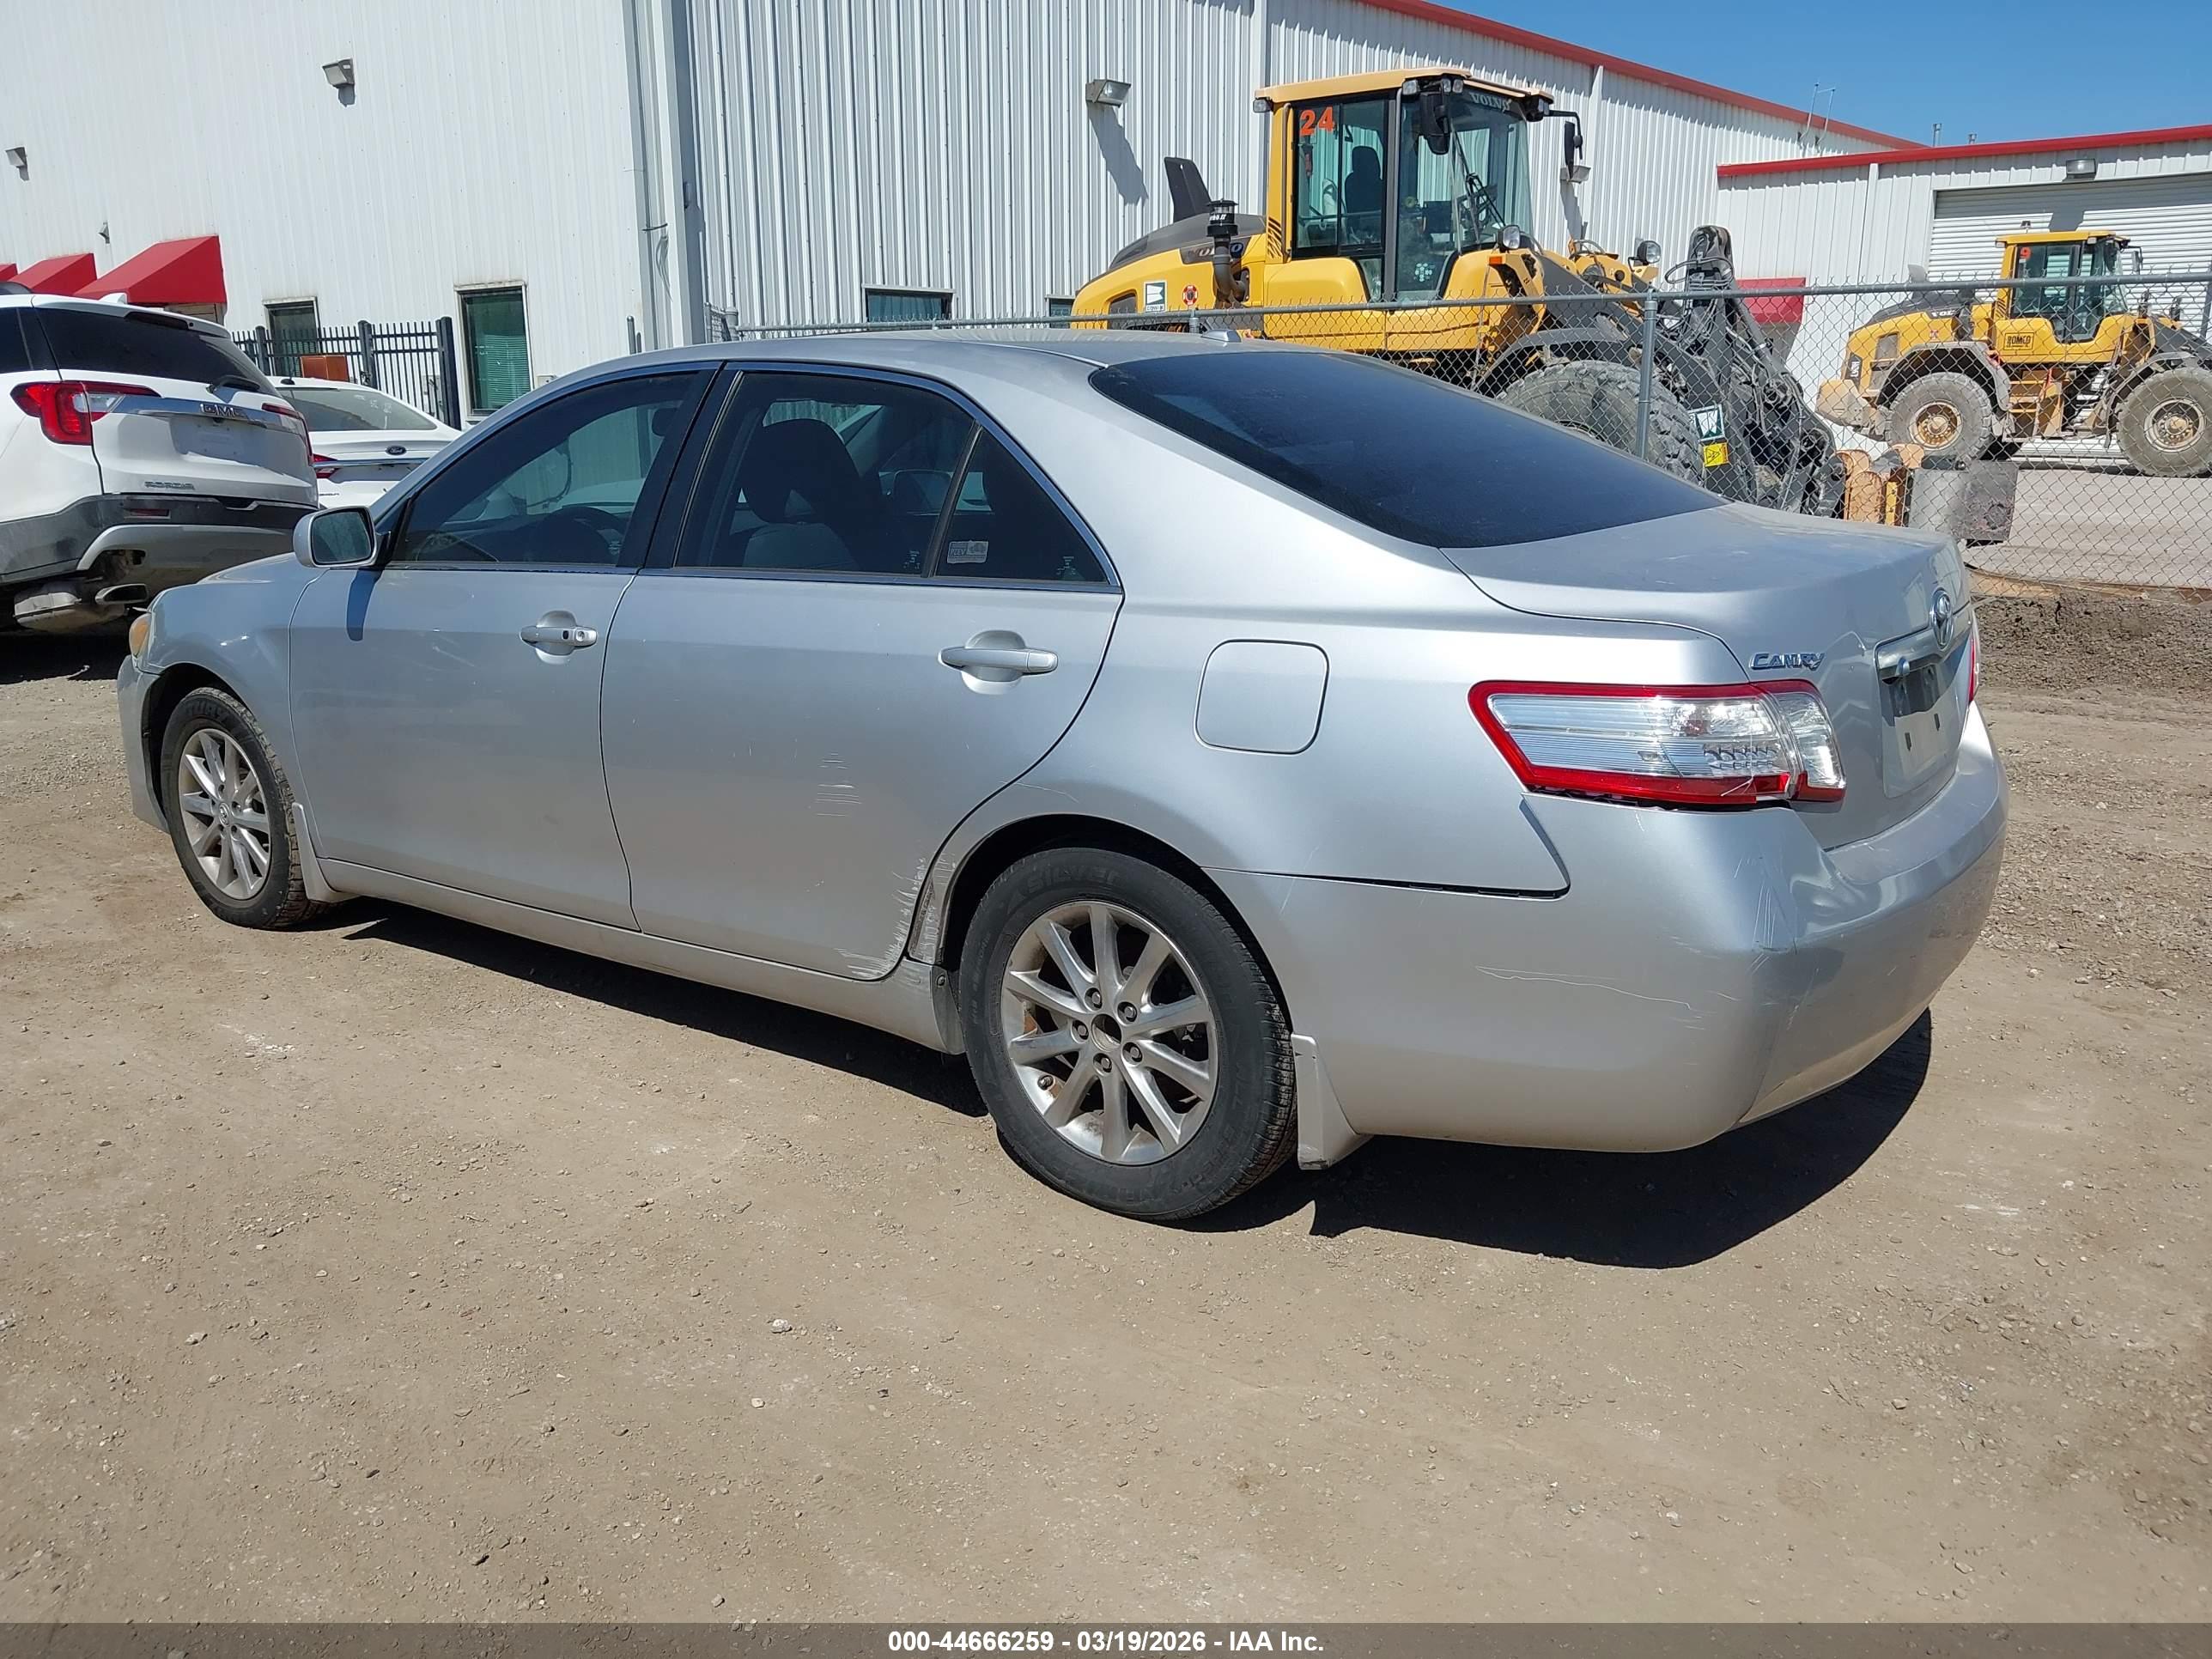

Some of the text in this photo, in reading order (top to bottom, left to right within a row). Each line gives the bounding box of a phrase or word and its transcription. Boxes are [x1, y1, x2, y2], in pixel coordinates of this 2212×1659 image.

[1299, 106, 1334, 136] 24
[1188, 243, 1243, 258] VOLO
[2020, 246, 2032, 261] 9
[199, 403, 247, 419] GMC
[1749, 653, 1825, 671] CAMRY
